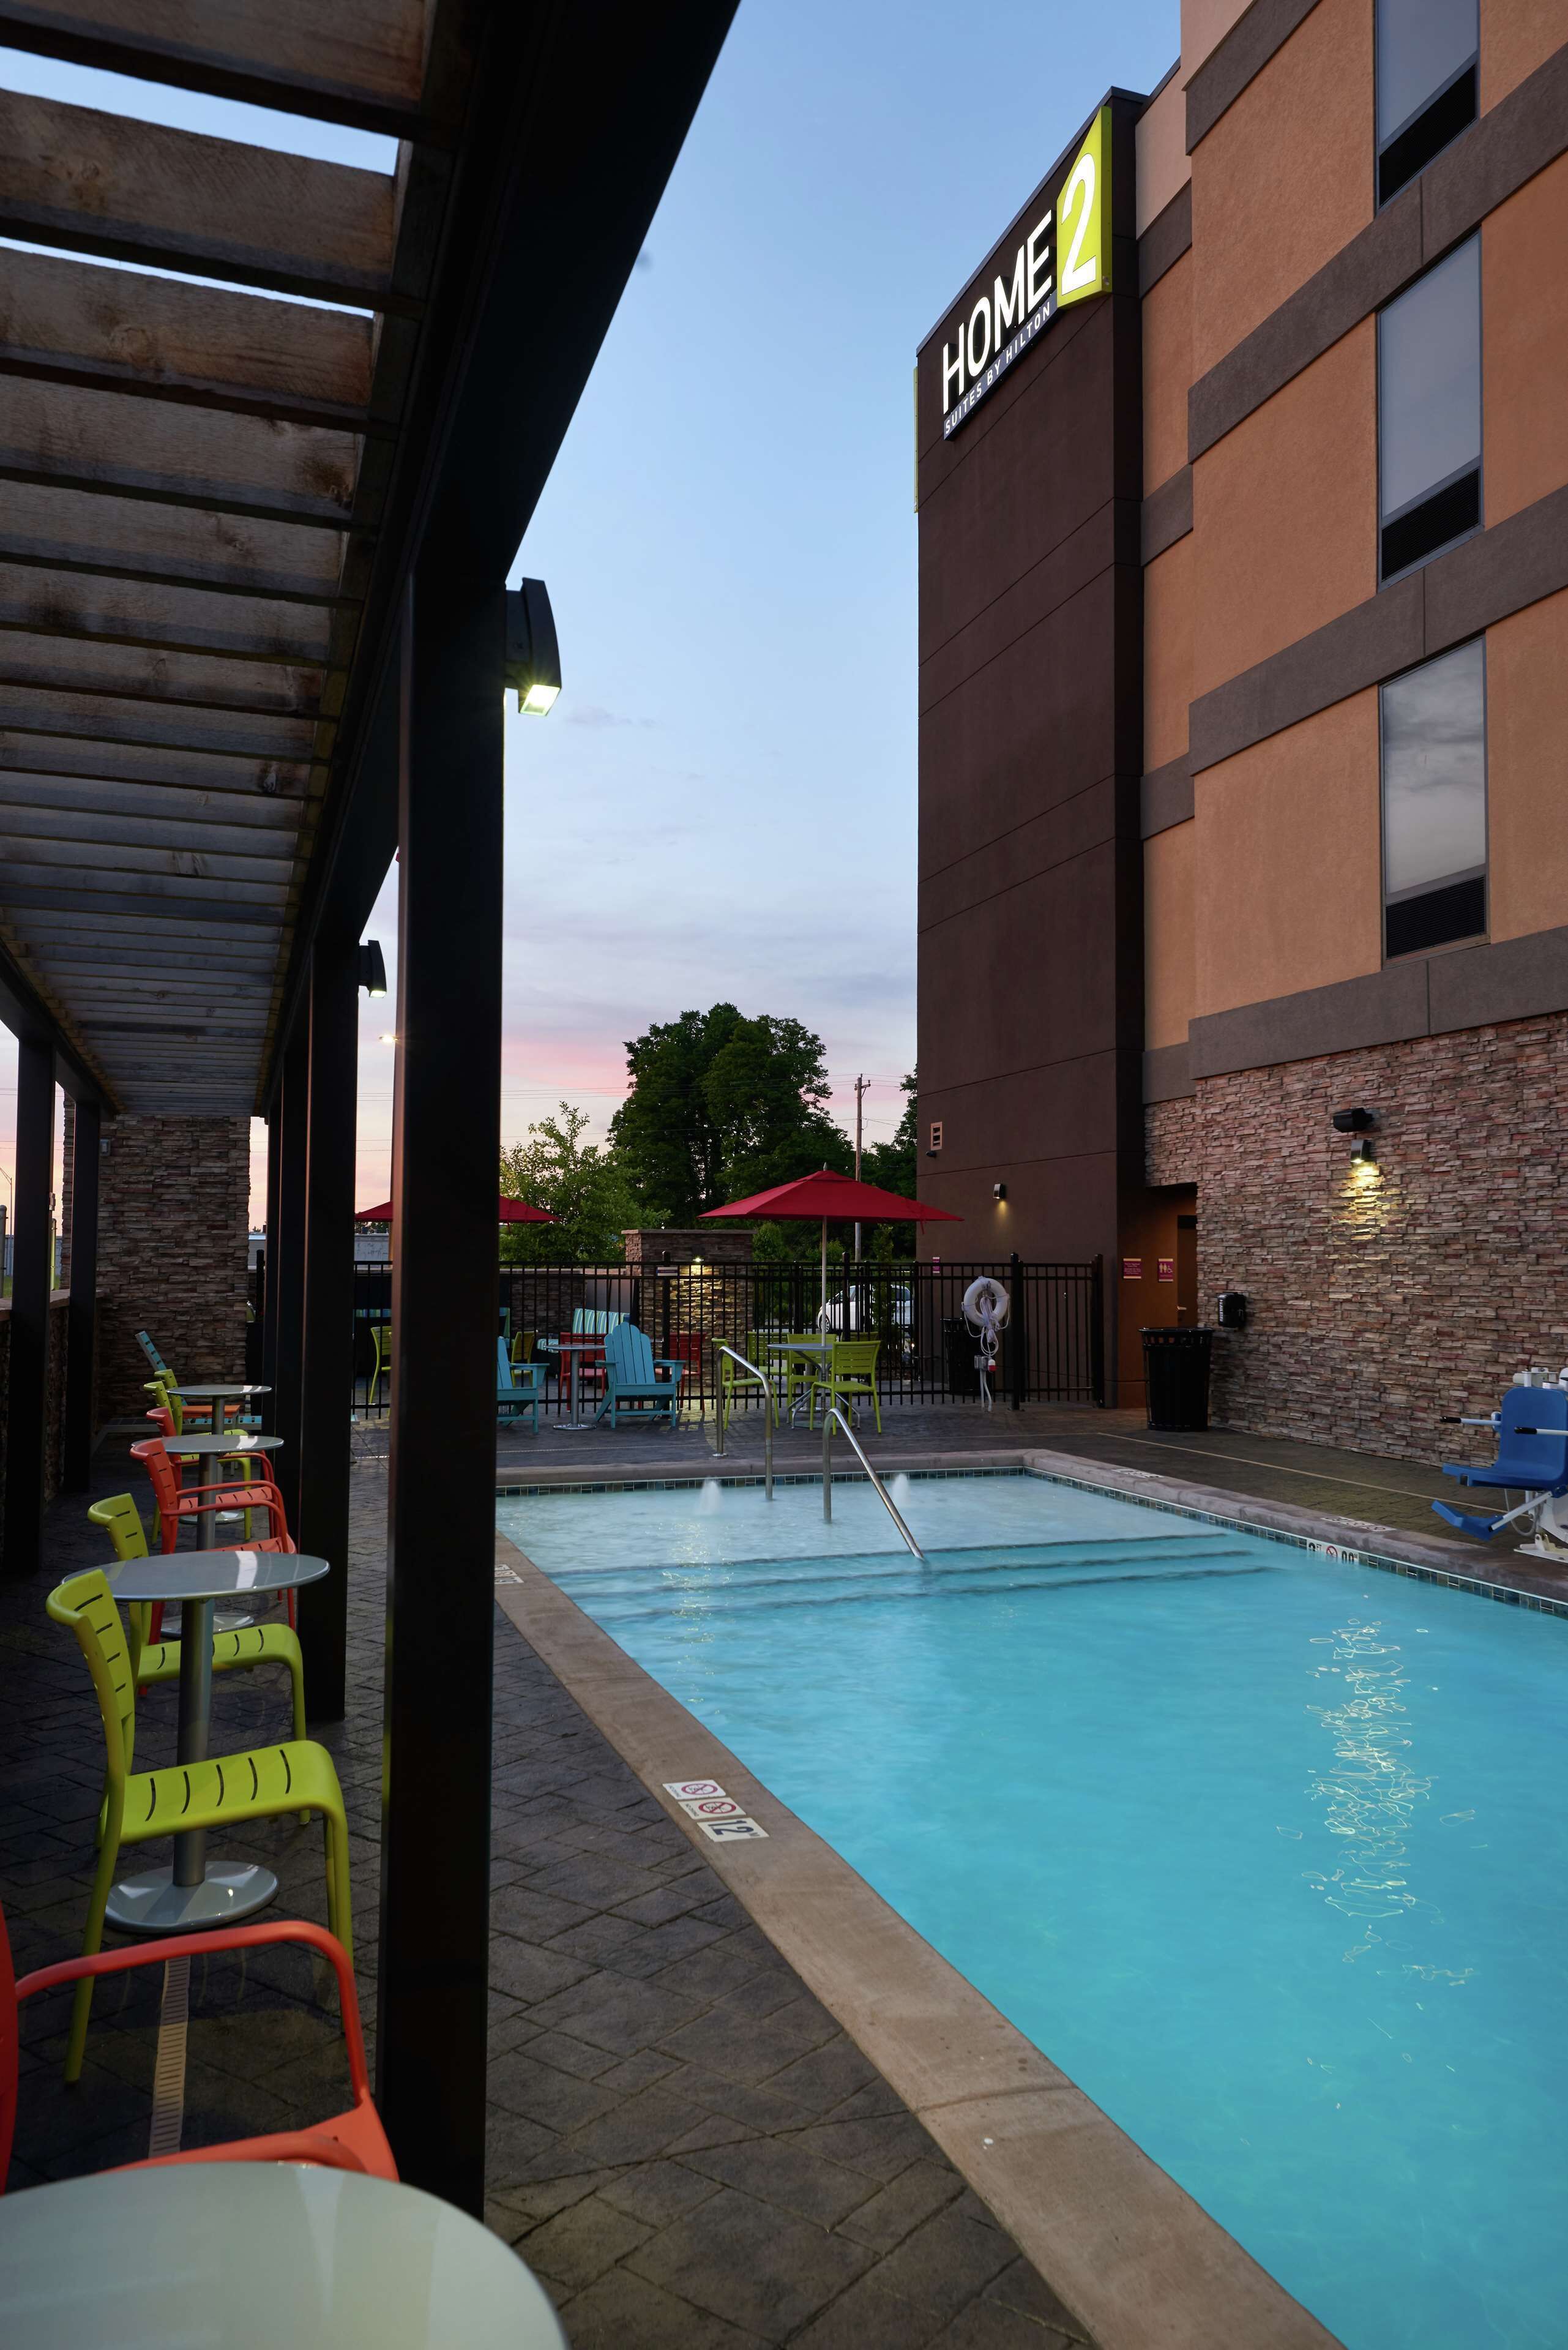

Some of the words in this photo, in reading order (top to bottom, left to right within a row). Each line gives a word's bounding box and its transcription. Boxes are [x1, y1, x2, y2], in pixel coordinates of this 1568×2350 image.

[943, 209, 1051, 415] HOME
[1061, 152, 1096, 296] 2
[945, 383, 982, 434] SUITES
[987, 359, 1001, 385] BY
[1006, 302, 1050, 364] HILTON
